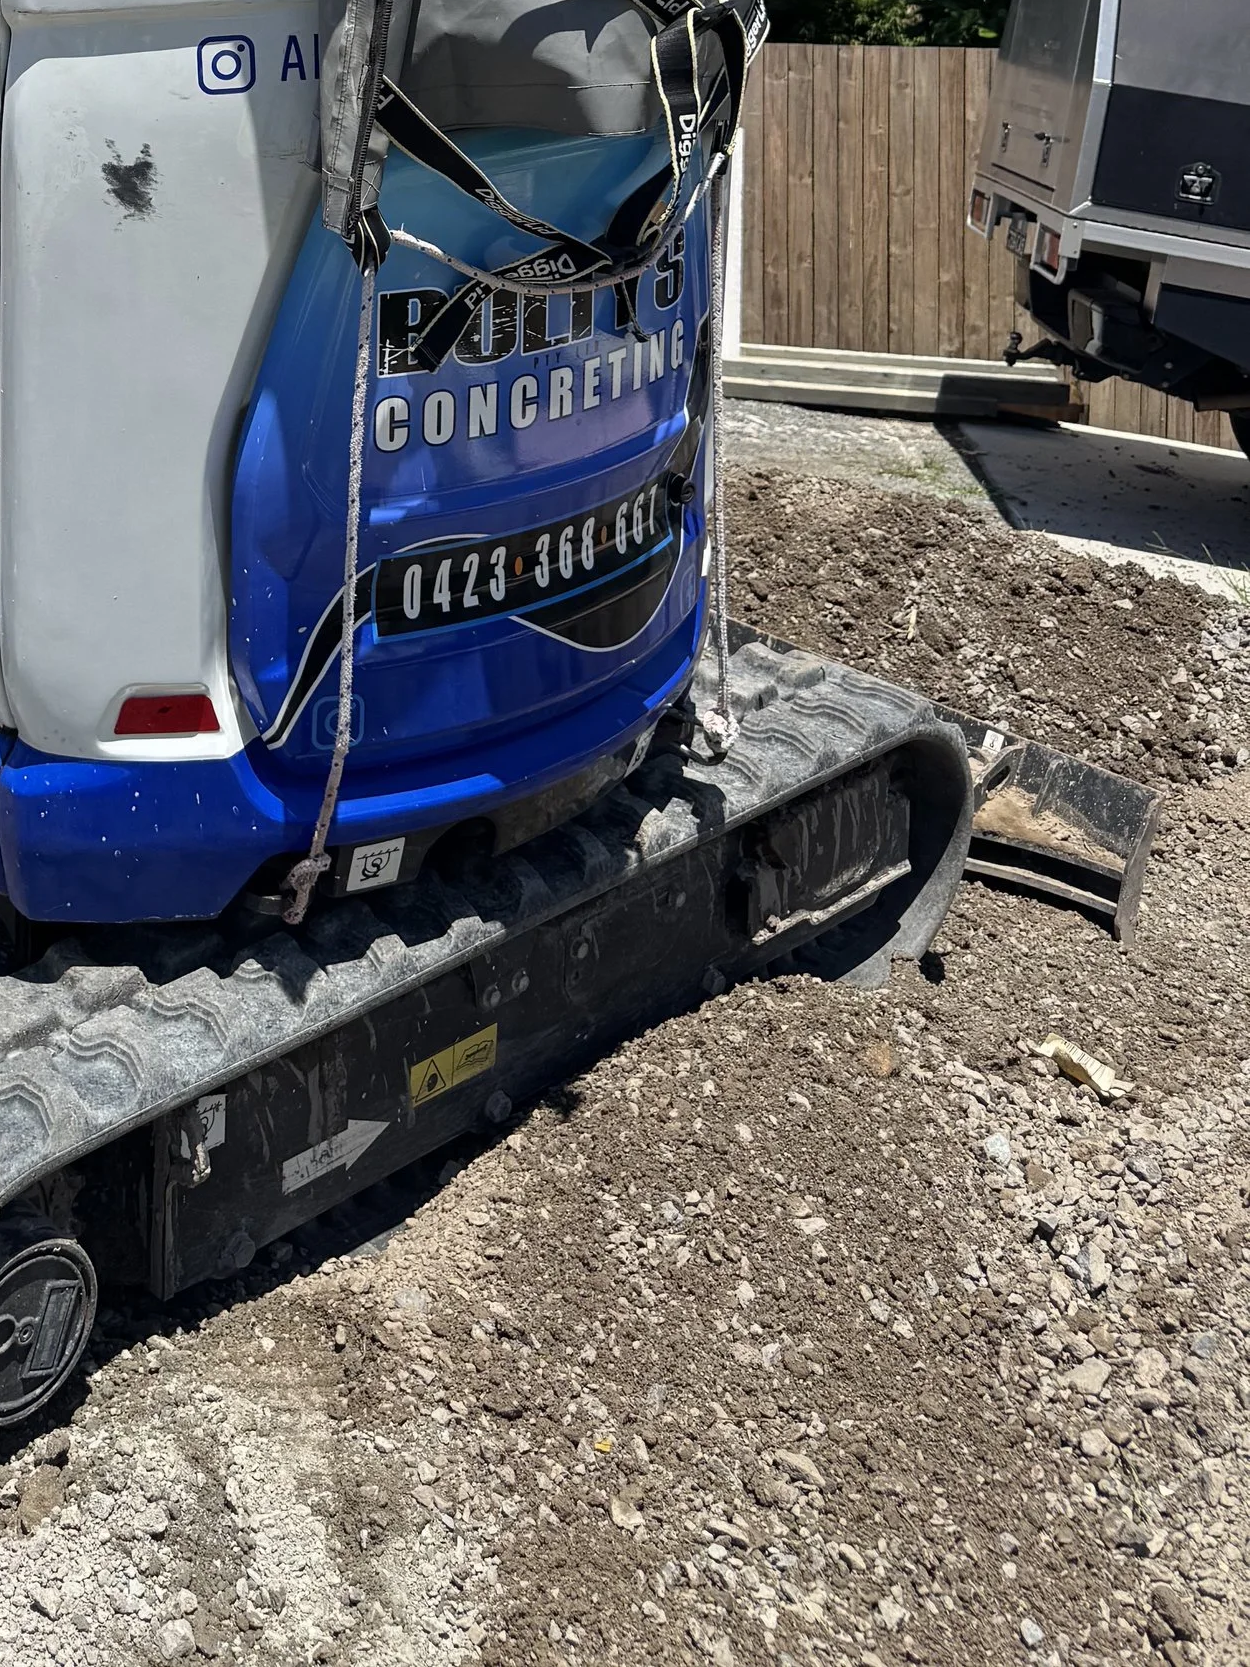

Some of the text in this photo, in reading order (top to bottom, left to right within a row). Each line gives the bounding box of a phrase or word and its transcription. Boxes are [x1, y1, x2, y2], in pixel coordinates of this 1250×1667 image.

[475, 188, 559, 236] DiggerLid
[373, 318, 685, 454] CONCRETING
[402, 483, 659, 620] 0423 368 667
